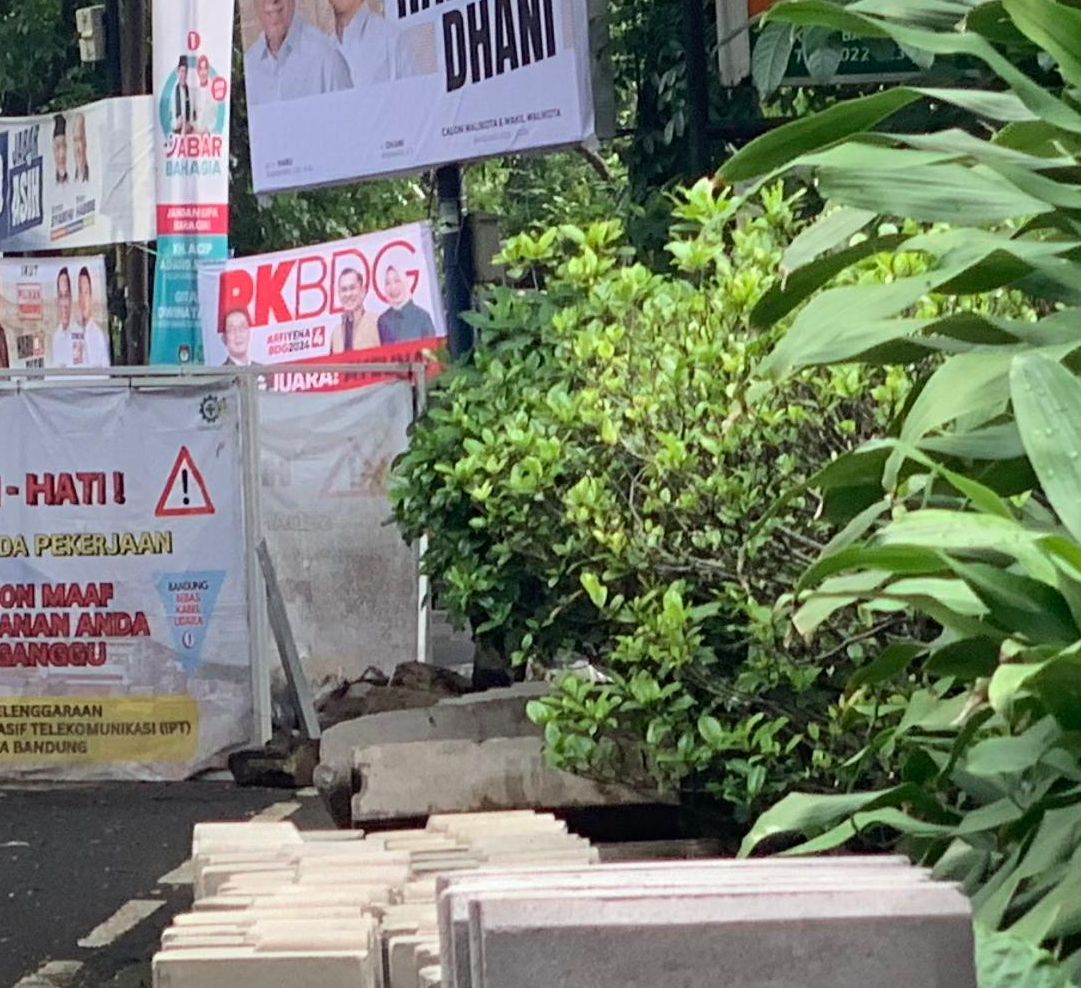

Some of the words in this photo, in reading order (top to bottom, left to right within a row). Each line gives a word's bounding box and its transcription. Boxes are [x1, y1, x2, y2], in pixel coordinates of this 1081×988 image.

[165, 134, 223, 159] JABAR
[166, 160, 221, 176] BAHAGIA
[11, 165, 41, 227] ASIH
[33, 530, 174, 558] PEKERJAAN
[41, 582, 114, 608] MAAF
[167, 580, 209, 592] BANDUNG
[74, 611, 151, 637] ANDA
[31, 721, 156, 736] TELEKOMUNIKASI
[159, 720, 191, 736] (IPT)
[13, 740, 88, 754] BANDUNG
